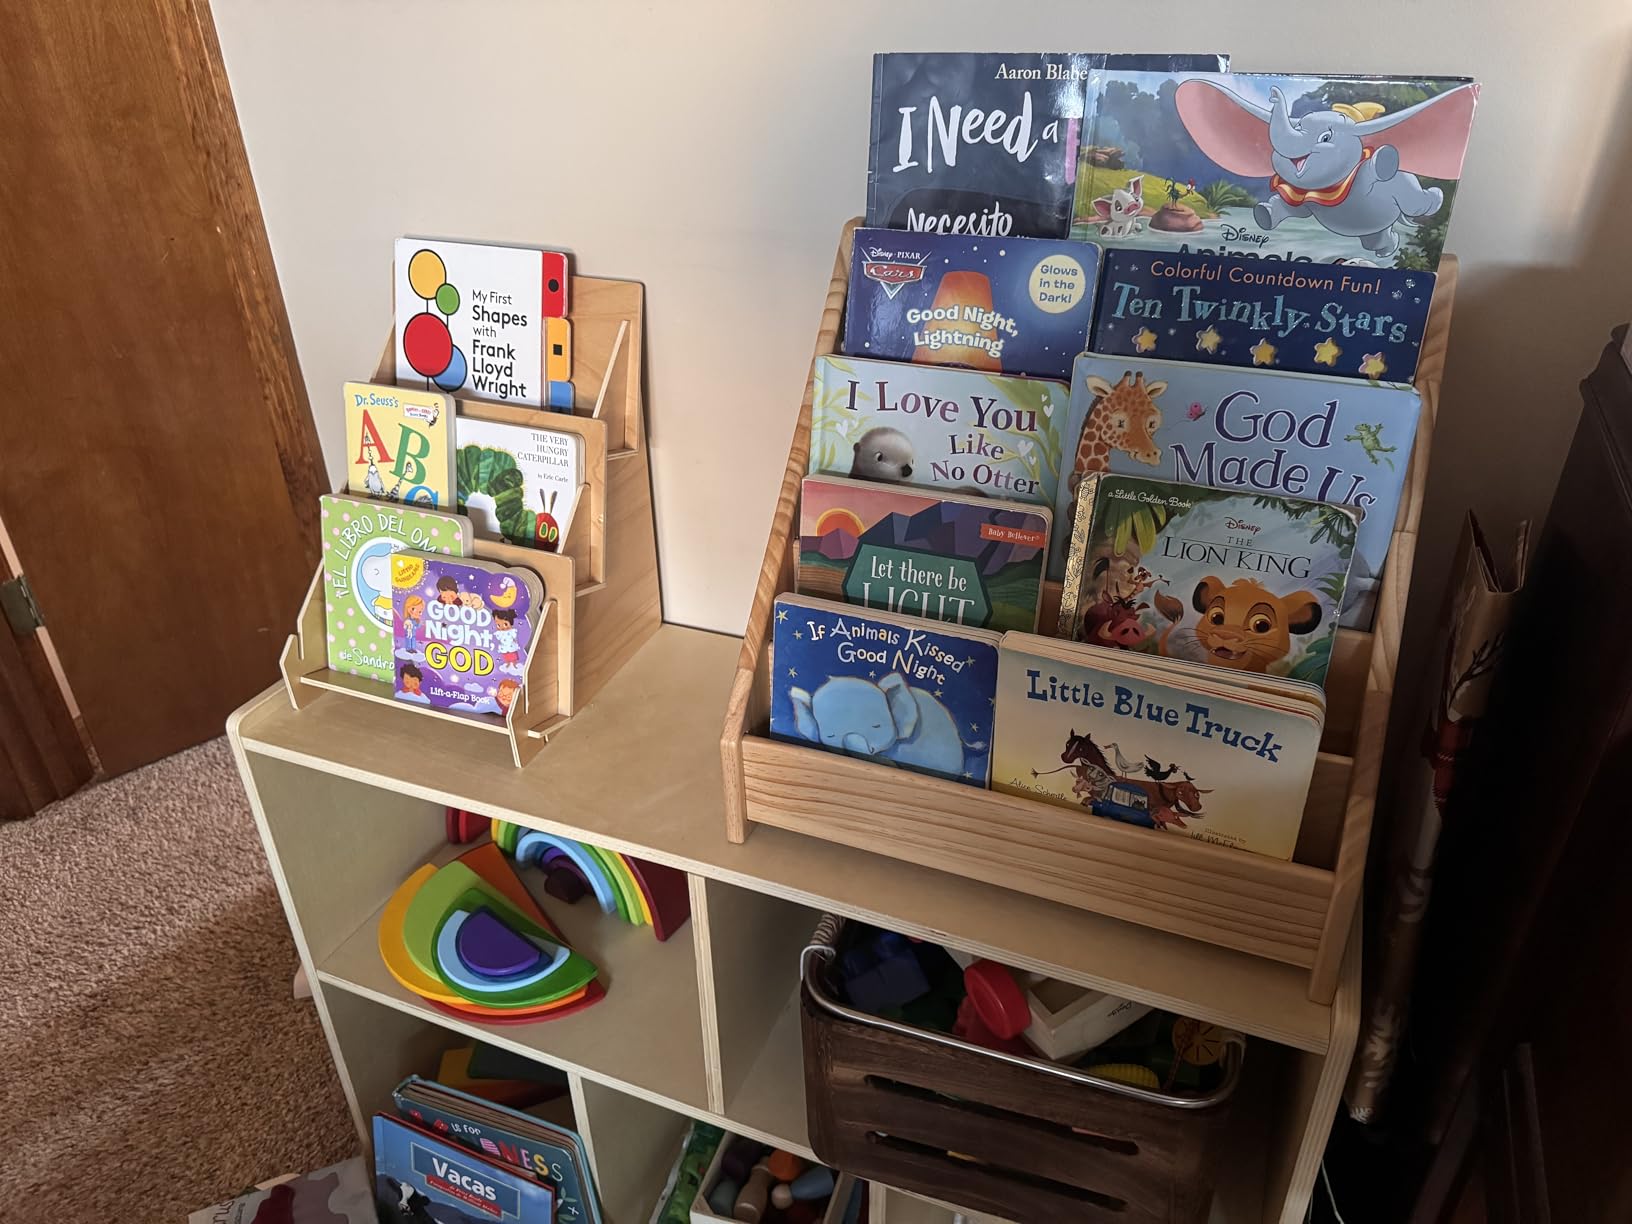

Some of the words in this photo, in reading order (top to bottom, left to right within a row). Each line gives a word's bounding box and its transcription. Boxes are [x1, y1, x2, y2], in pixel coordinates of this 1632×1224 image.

[994, 63, 1041, 80] Aaron
[1045, 63, 1088, 80] Blabe
[893, 106, 919, 173] I
[927, 91, 1038, 174] Need
[1042, 120, 1058, 143] a
[907, 201, 1013, 236] Necesito
[897, 251, 921, 260] PIXAR
[870, 265, 915, 278] Cars
[1040, 264, 1078, 277] Glows
[1151, 260, 1222, 281] Colorful
[1229, 267, 1334, 291] Countdown
[1340, 276, 1382, 295] Fun!
[472, 289, 488, 304] My
[489, 291, 512, 305] First
[1039, 278, 1051, 289] in
[1054, 279, 1075, 290] the
[1039, 292, 1072, 303] Dark!
[472, 304, 528, 329] Shapes
[906, 305, 959, 324] Good
[963, 306, 1019, 337] Night,
[1112, 282, 1163, 320] Ten
[1172, 285, 1310, 338] Twinkly
[1314, 302, 1408, 344] Stars
[473, 325, 497, 338] with
[913, 329, 1005, 358] Lightning
[472, 339, 516, 360] Frank
[472, 356, 513, 381] Lloyd
[472, 374, 527, 399] Wright
[354, 394, 369, 407] Dr.
[369, 392, 399, 408] Seuss's
[845, 380, 860, 411] I
[875, 381, 959, 423] Love
[970, 396, 1038, 432] You
[1214, 390, 1339, 448] God
[530, 432, 548, 443] THE
[549, 435, 568, 446] VERY
[536, 444, 568, 456] HUNGRY
[948, 433, 1004, 460] Like
[517, 451, 569, 467] CATERPILLAR
[1169, 443, 1310, 494] Made
[930, 460, 964, 482] No
[972, 463, 1040, 495] Otter
[1114, 489, 1137, 500] Little
[1137, 492, 1168, 505] Golden
[1168, 496, 1191, 508] Book
[334, 515, 373, 560] LIBRO
[377, 513, 406, 536] DEL
[988, 528, 1005, 538] Baby
[1226, 536, 1253, 546] THE
[1161, 536, 1230, 566] LION
[1236, 550, 1311, 579] KING
[871, 555, 894, 579] Let
[899, 559, 943, 587] there
[948, 566, 967, 592] be
[427, 600, 492, 627] GOOD
[425, 641, 495, 676] GOD
[806, 621, 825, 641] If
[830, 618, 900, 645] Animals
[904, 629, 965, 673] Kissed
[837, 641, 886, 663] Good
[892, 649, 945, 685] Night
[429, 686, 470, 702] Lift-a-Flap
[1026, 669, 1105, 708] Little
[1113, 685, 1179, 727] Blue
[1185, 703, 1283, 763] Truck
[432, 1157, 497, 1201] Vacas
